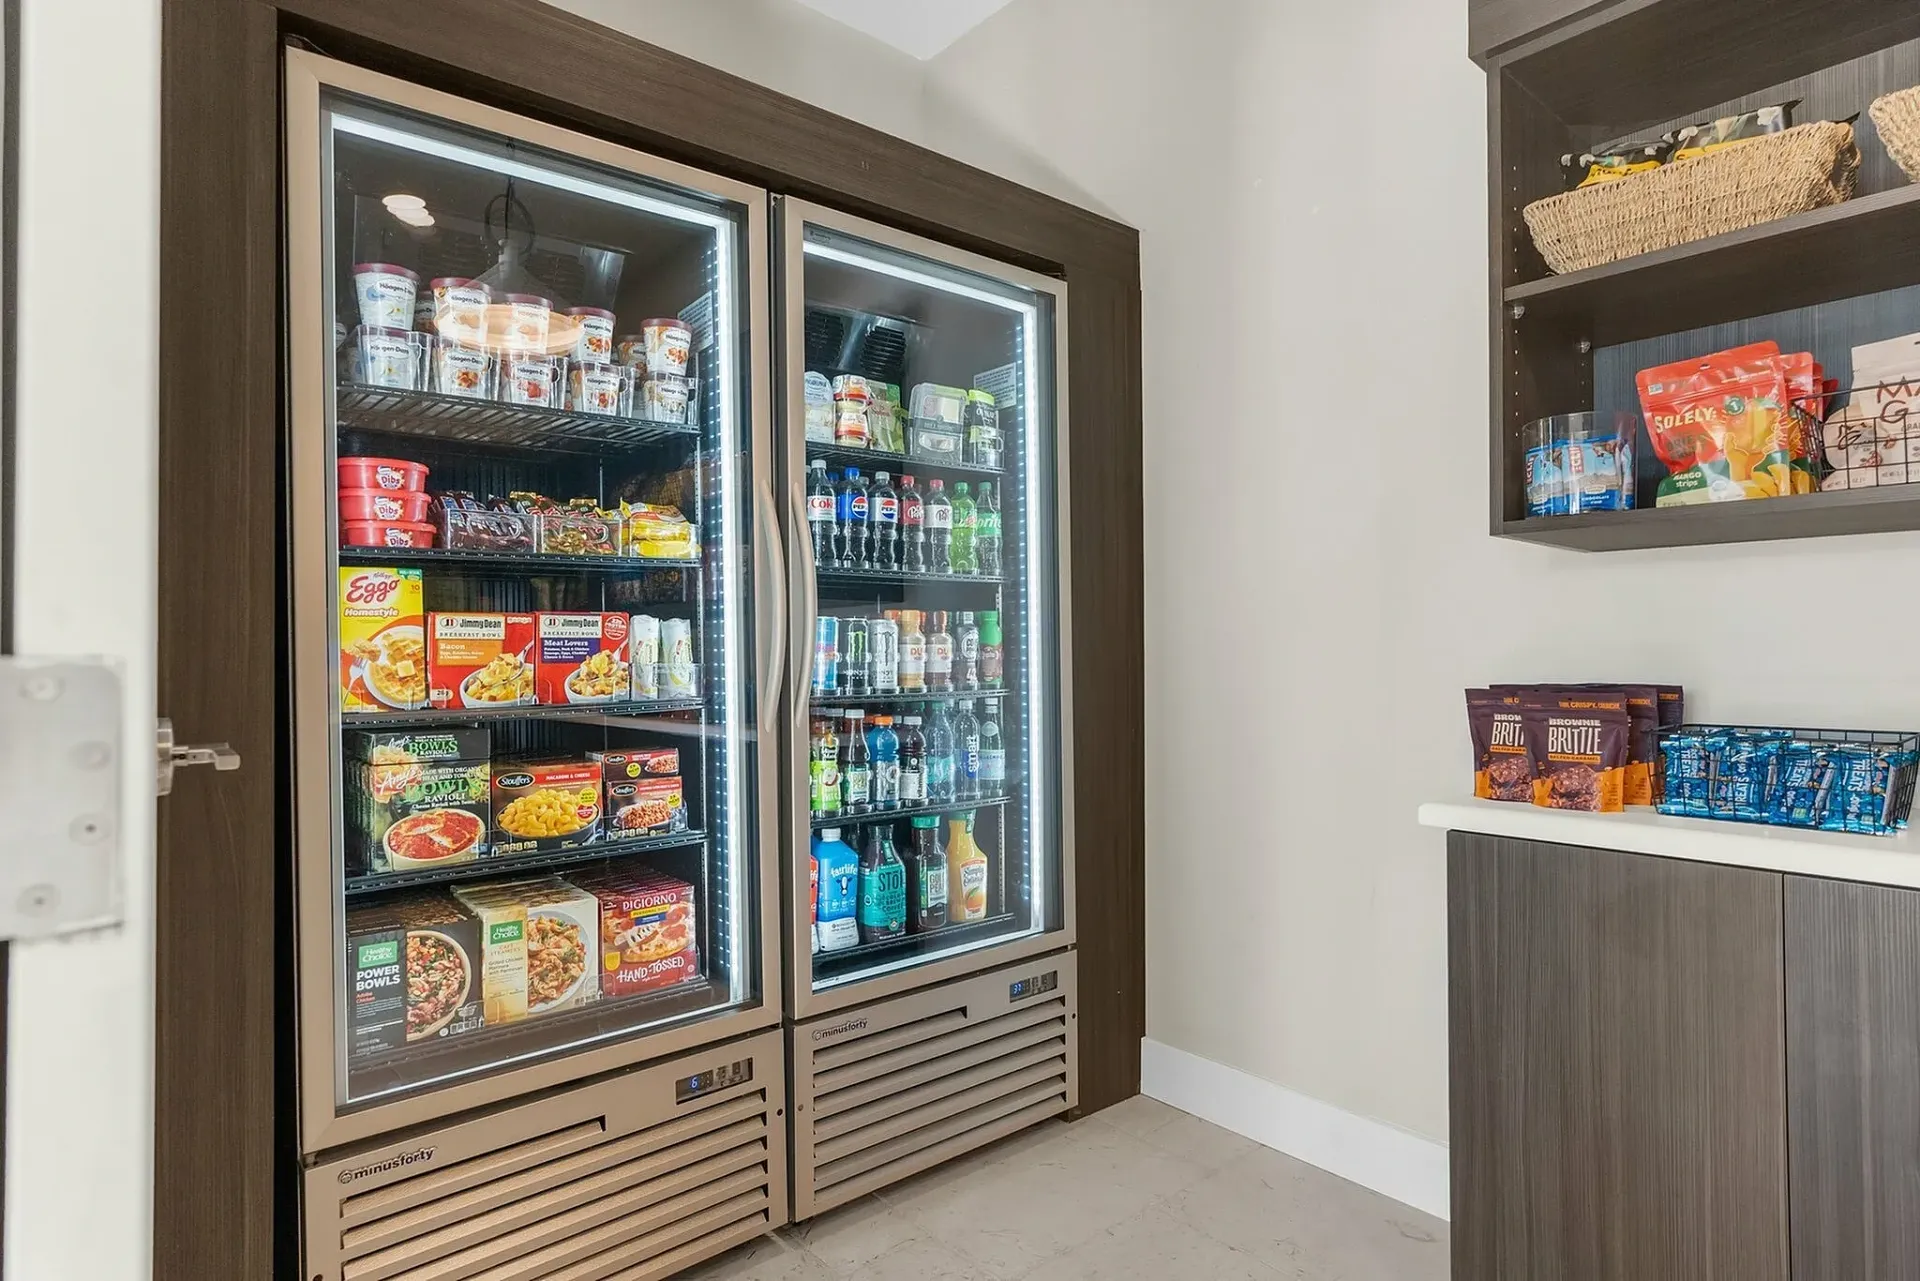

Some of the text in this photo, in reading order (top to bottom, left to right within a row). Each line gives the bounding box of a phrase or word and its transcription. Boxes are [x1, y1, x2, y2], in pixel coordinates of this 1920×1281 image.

[1654, 407, 1716, 434] SOLELY
[381, 475, 400, 485] Dibs
[1675, 480, 1699, 488] strips
[379, 505, 399, 515] Dibs
[811, 498, 834, 509] Cok
[390, 537, 409, 546] Dibs
[346, 575, 401, 604] Eggo
[344, 606, 400, 619] Homestyle
[460, 618, 484, 629] Jimmy
[484, 619, 502, 629] Dean
[561, 618, 599, 628] Jimmy Dean
[1549, 717, 1601, 726] BROWNIE
[408, 740, 458, 756] BOWLS
[1549, 727, 1603, 755] BRITTLE
[966, 734, 980, 773] smart
[1681, 750, 1691, 777] TREATS
[1848, 760, 1865, 792] TREATS
[404, 778, 482, 803] BOWLS
[424, 792, 465, 803] RAVIOLI
[830, 863, 858, 878] fairlife
[622, 893, 677, 910] DIGIORNO
[493, 931, 520, 940] Choice
[496, 925, 518, 934] Healthy
[362, 952, 393, 962] Choice
[365, 947, 392, 956] Healthy
[356, 964, 400, 981] POWER
[356, 974, 400, 991] BOWLS
[822, 1020, 868, 1038] minusforty
[354, 1147, 434, 1179] minusforty
